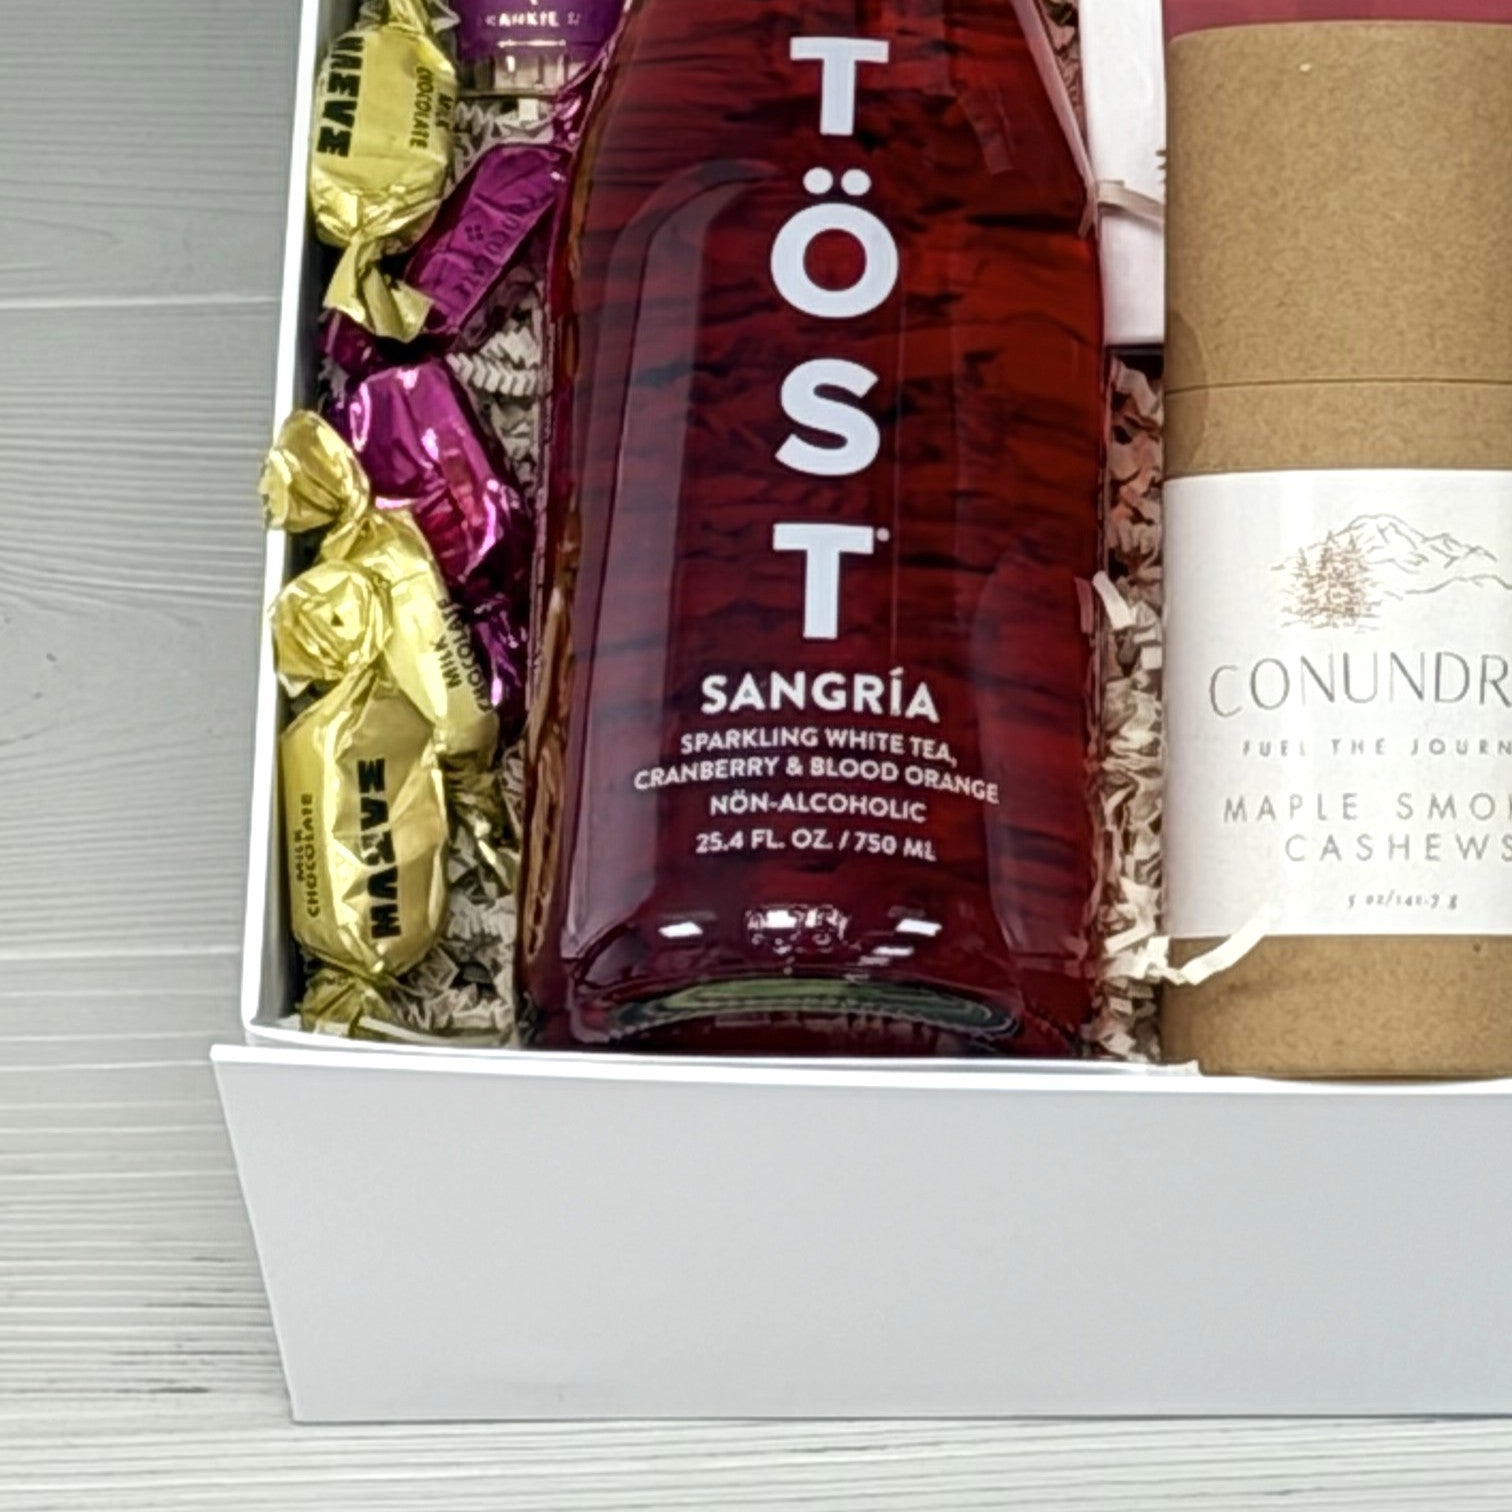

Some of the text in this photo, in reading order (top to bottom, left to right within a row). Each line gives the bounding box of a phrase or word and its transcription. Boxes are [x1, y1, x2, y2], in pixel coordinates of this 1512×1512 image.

[770, 35, 900, 640] TÖST
[701, 667, 940, 723] SANGRÍA
[680, 727, 958, 768] SPARKLING WHITE TEA,
[1243, 738, 1306, 757] FUEL
[1331, 738, 1386, 757] THE
[633, 756, 1000, 805] CRANBERRY & BLOOD ORANGE
[709, 789, 928, 824] NÖN-ALCOHOLIC
[1224, 793, 1359, 824] MAPLE
[301, 793, 321, 919] CHOCOLATE
[695, 829, 744, 854] 25.4
[838, 830, 849, 852] /
[853, 831, 897, 857] 750
[903, 836, 938, 863] ML
